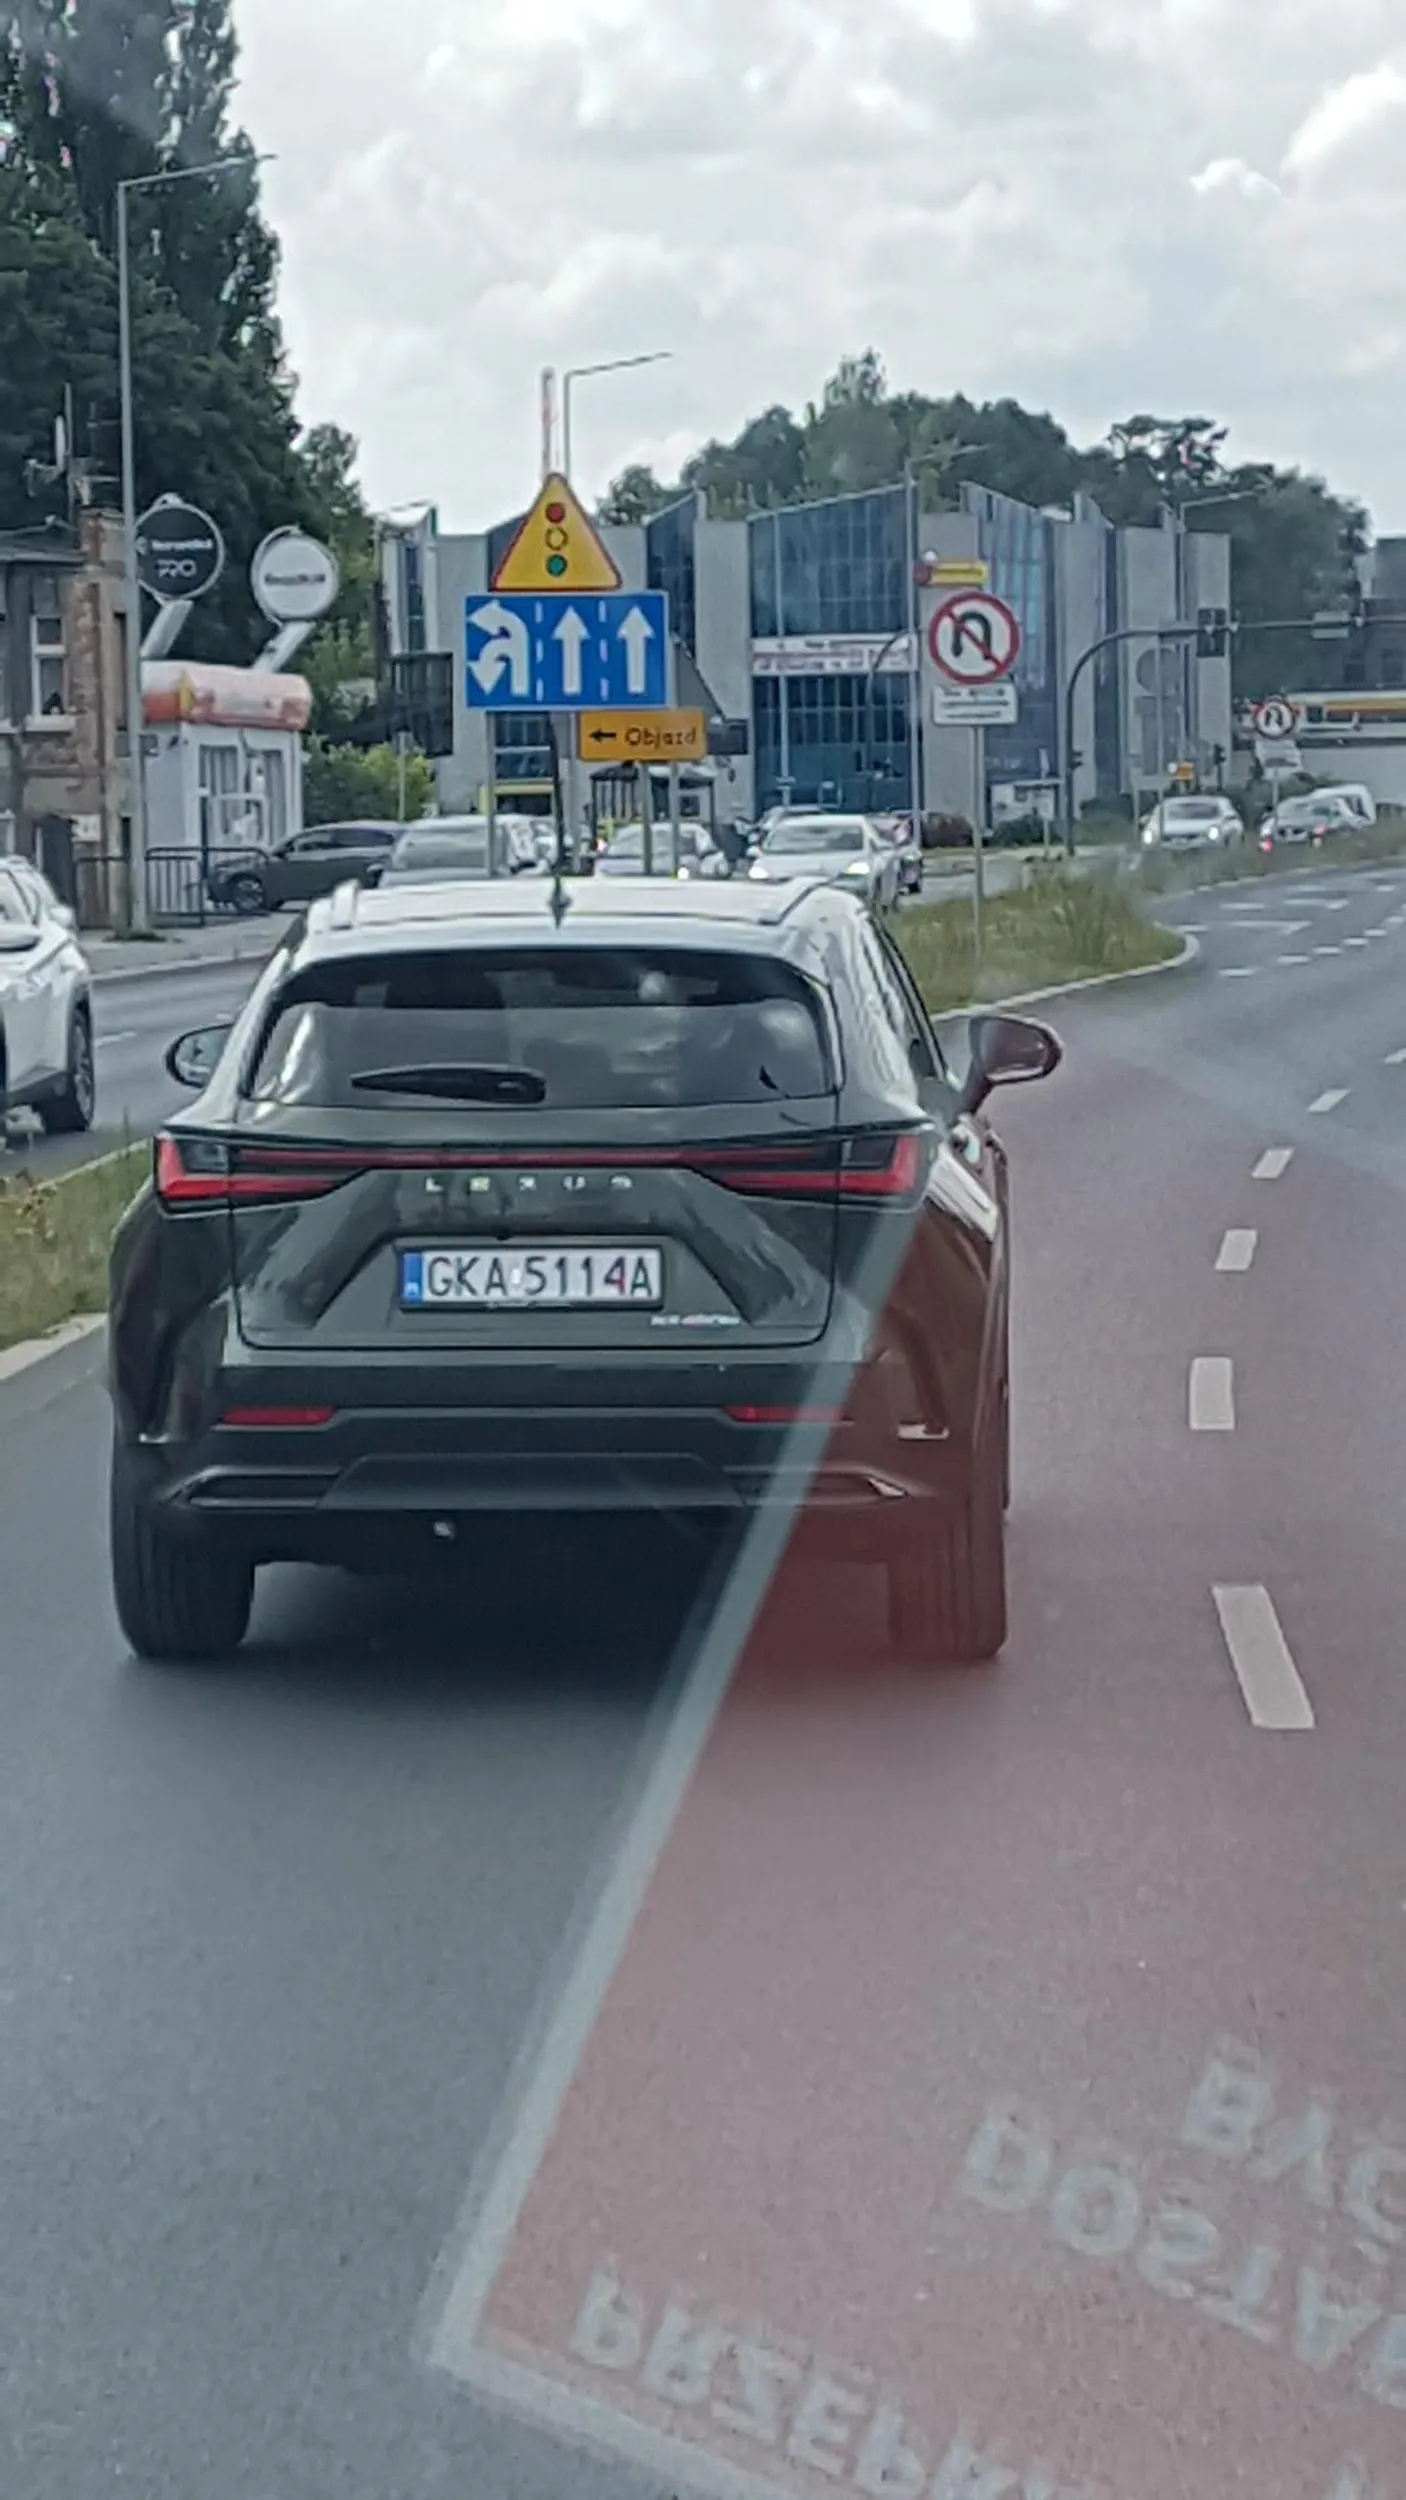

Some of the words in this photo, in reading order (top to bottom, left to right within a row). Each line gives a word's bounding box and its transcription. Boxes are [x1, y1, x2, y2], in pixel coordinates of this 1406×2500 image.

[625, 726, 697, 750] Objazd
[428, 1256, 508, 1297] GKA
[523, 1256, 653, 1297] 5114A
